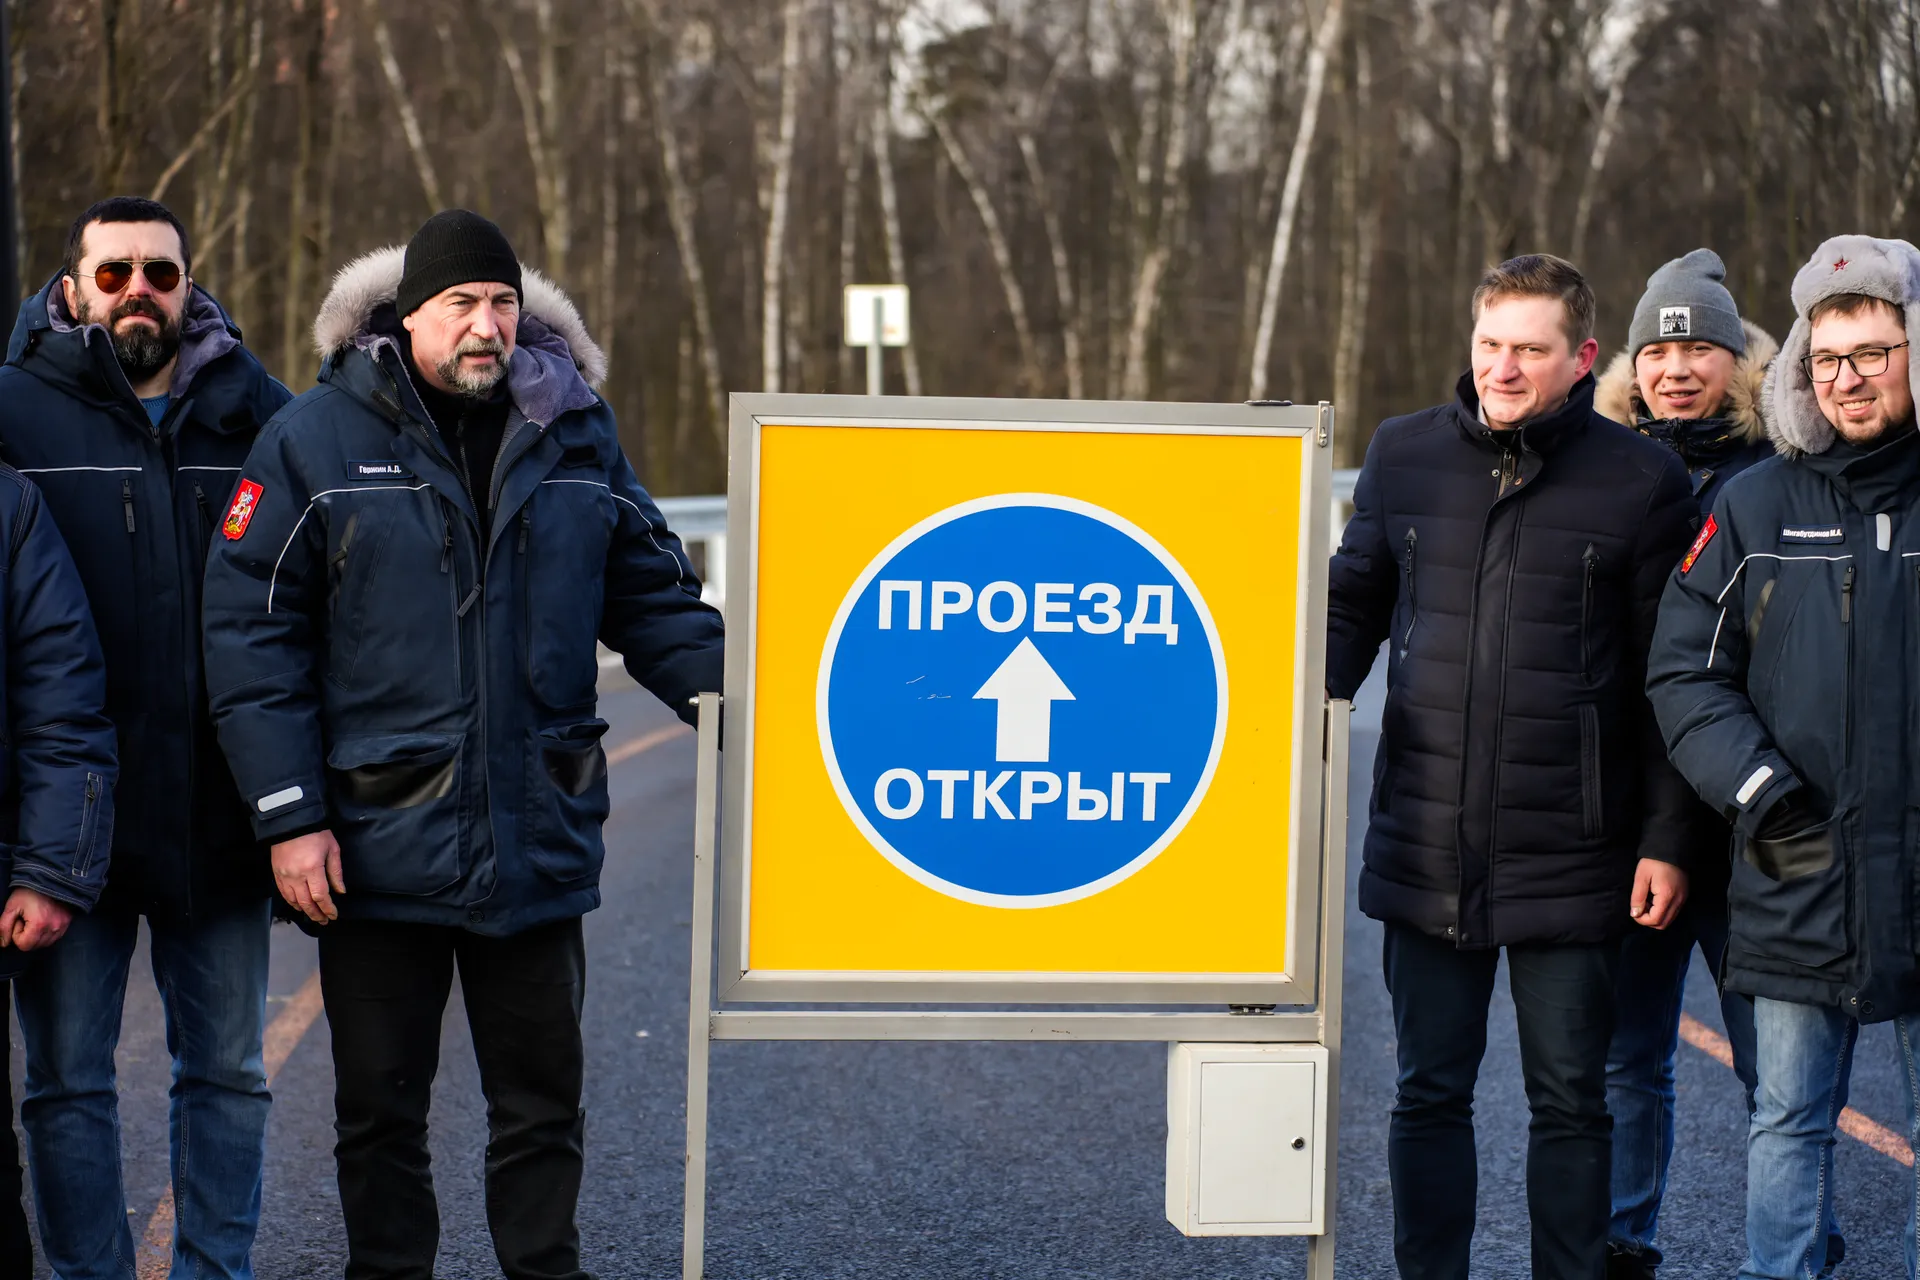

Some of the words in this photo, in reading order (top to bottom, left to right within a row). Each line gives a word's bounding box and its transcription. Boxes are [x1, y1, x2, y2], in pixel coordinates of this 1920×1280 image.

[387, 464, 402, 474] А.Д.
[878, 580, 1179, 645] ПРОЕЗД
[874, 768, 1171, 821] ОТКРЫТ
